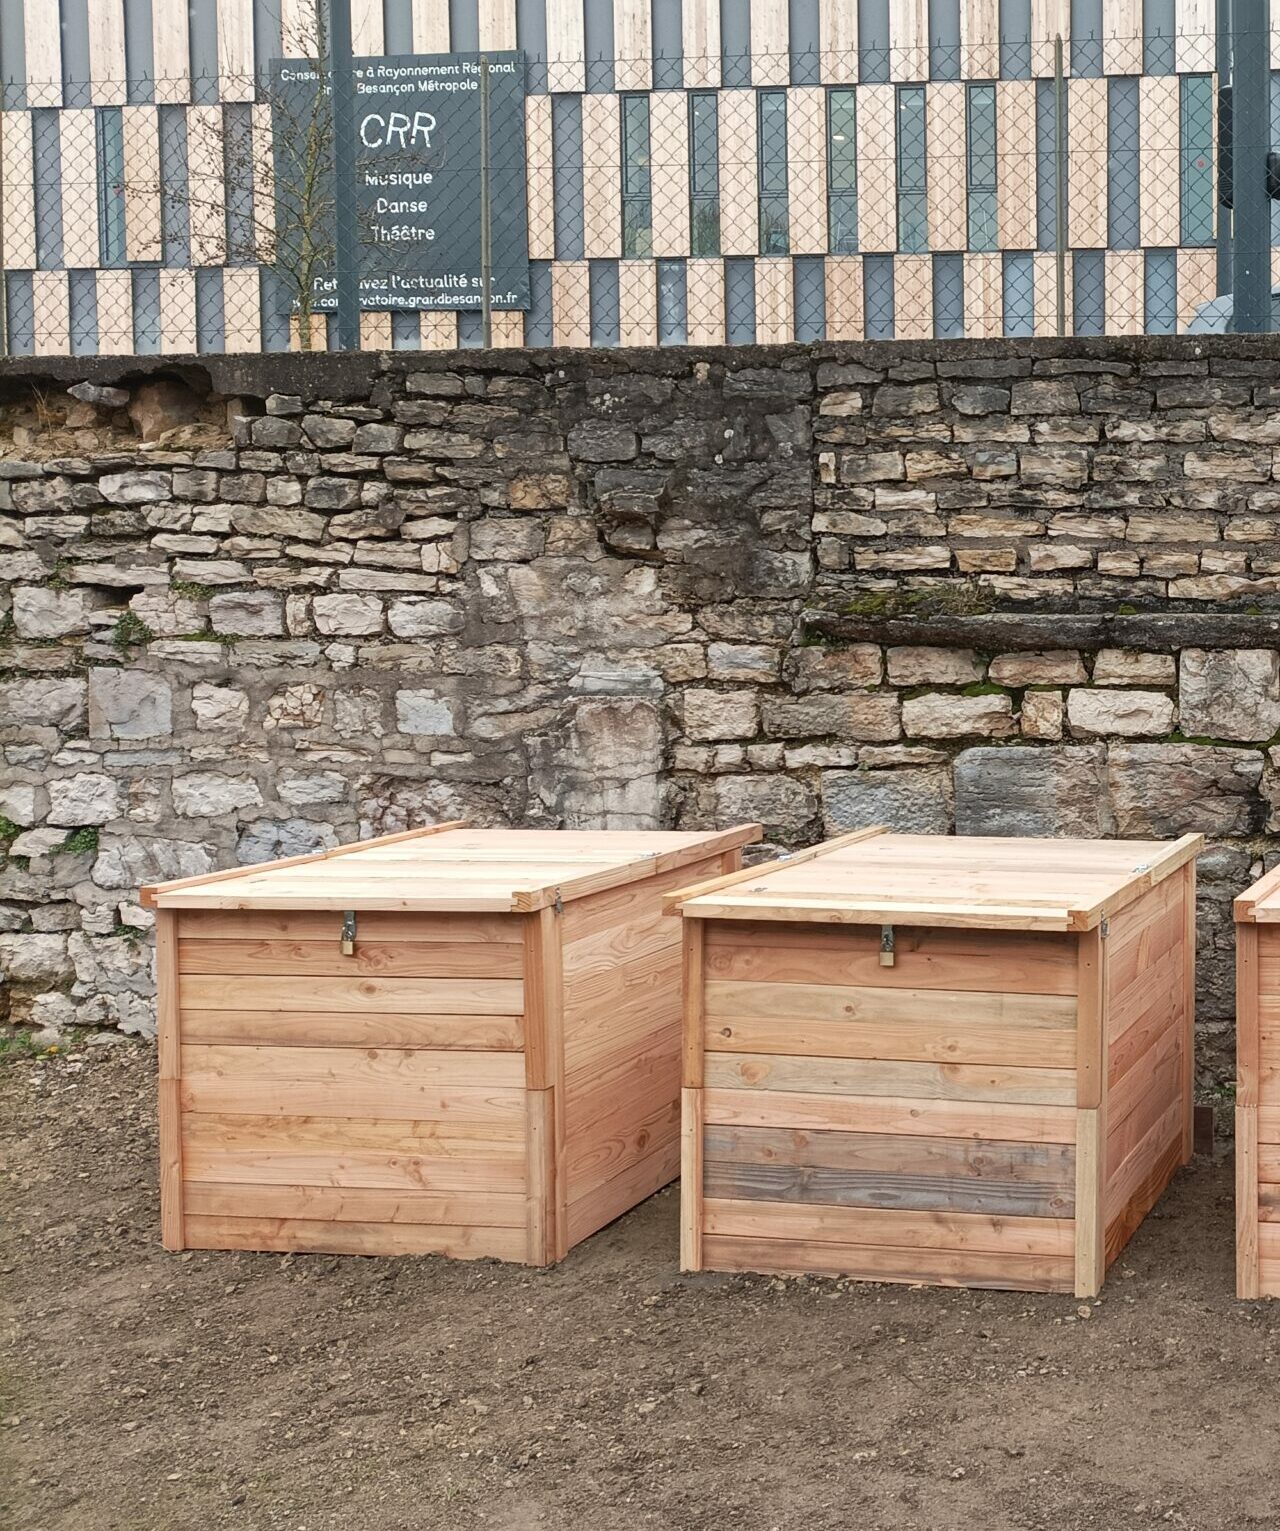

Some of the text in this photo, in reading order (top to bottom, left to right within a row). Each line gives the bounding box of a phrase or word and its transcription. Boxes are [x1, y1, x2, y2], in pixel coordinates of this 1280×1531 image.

[366, 66, 374, 78] à
[377, 64, 459, 80] Rayonnement
[462, 61, 515, 76] Réonal
[357, 78, 478, 96] Besançon Métropole
[360, 111, 437, 149] CRR
[365, 170, 433, 189] Musique
[377, 198, 428, 214] Danse
[371, 225, 435, 241] Théâtre
[314, 275, 387, 291] Retvez
[391, 273, 467, 289] l'actualité
